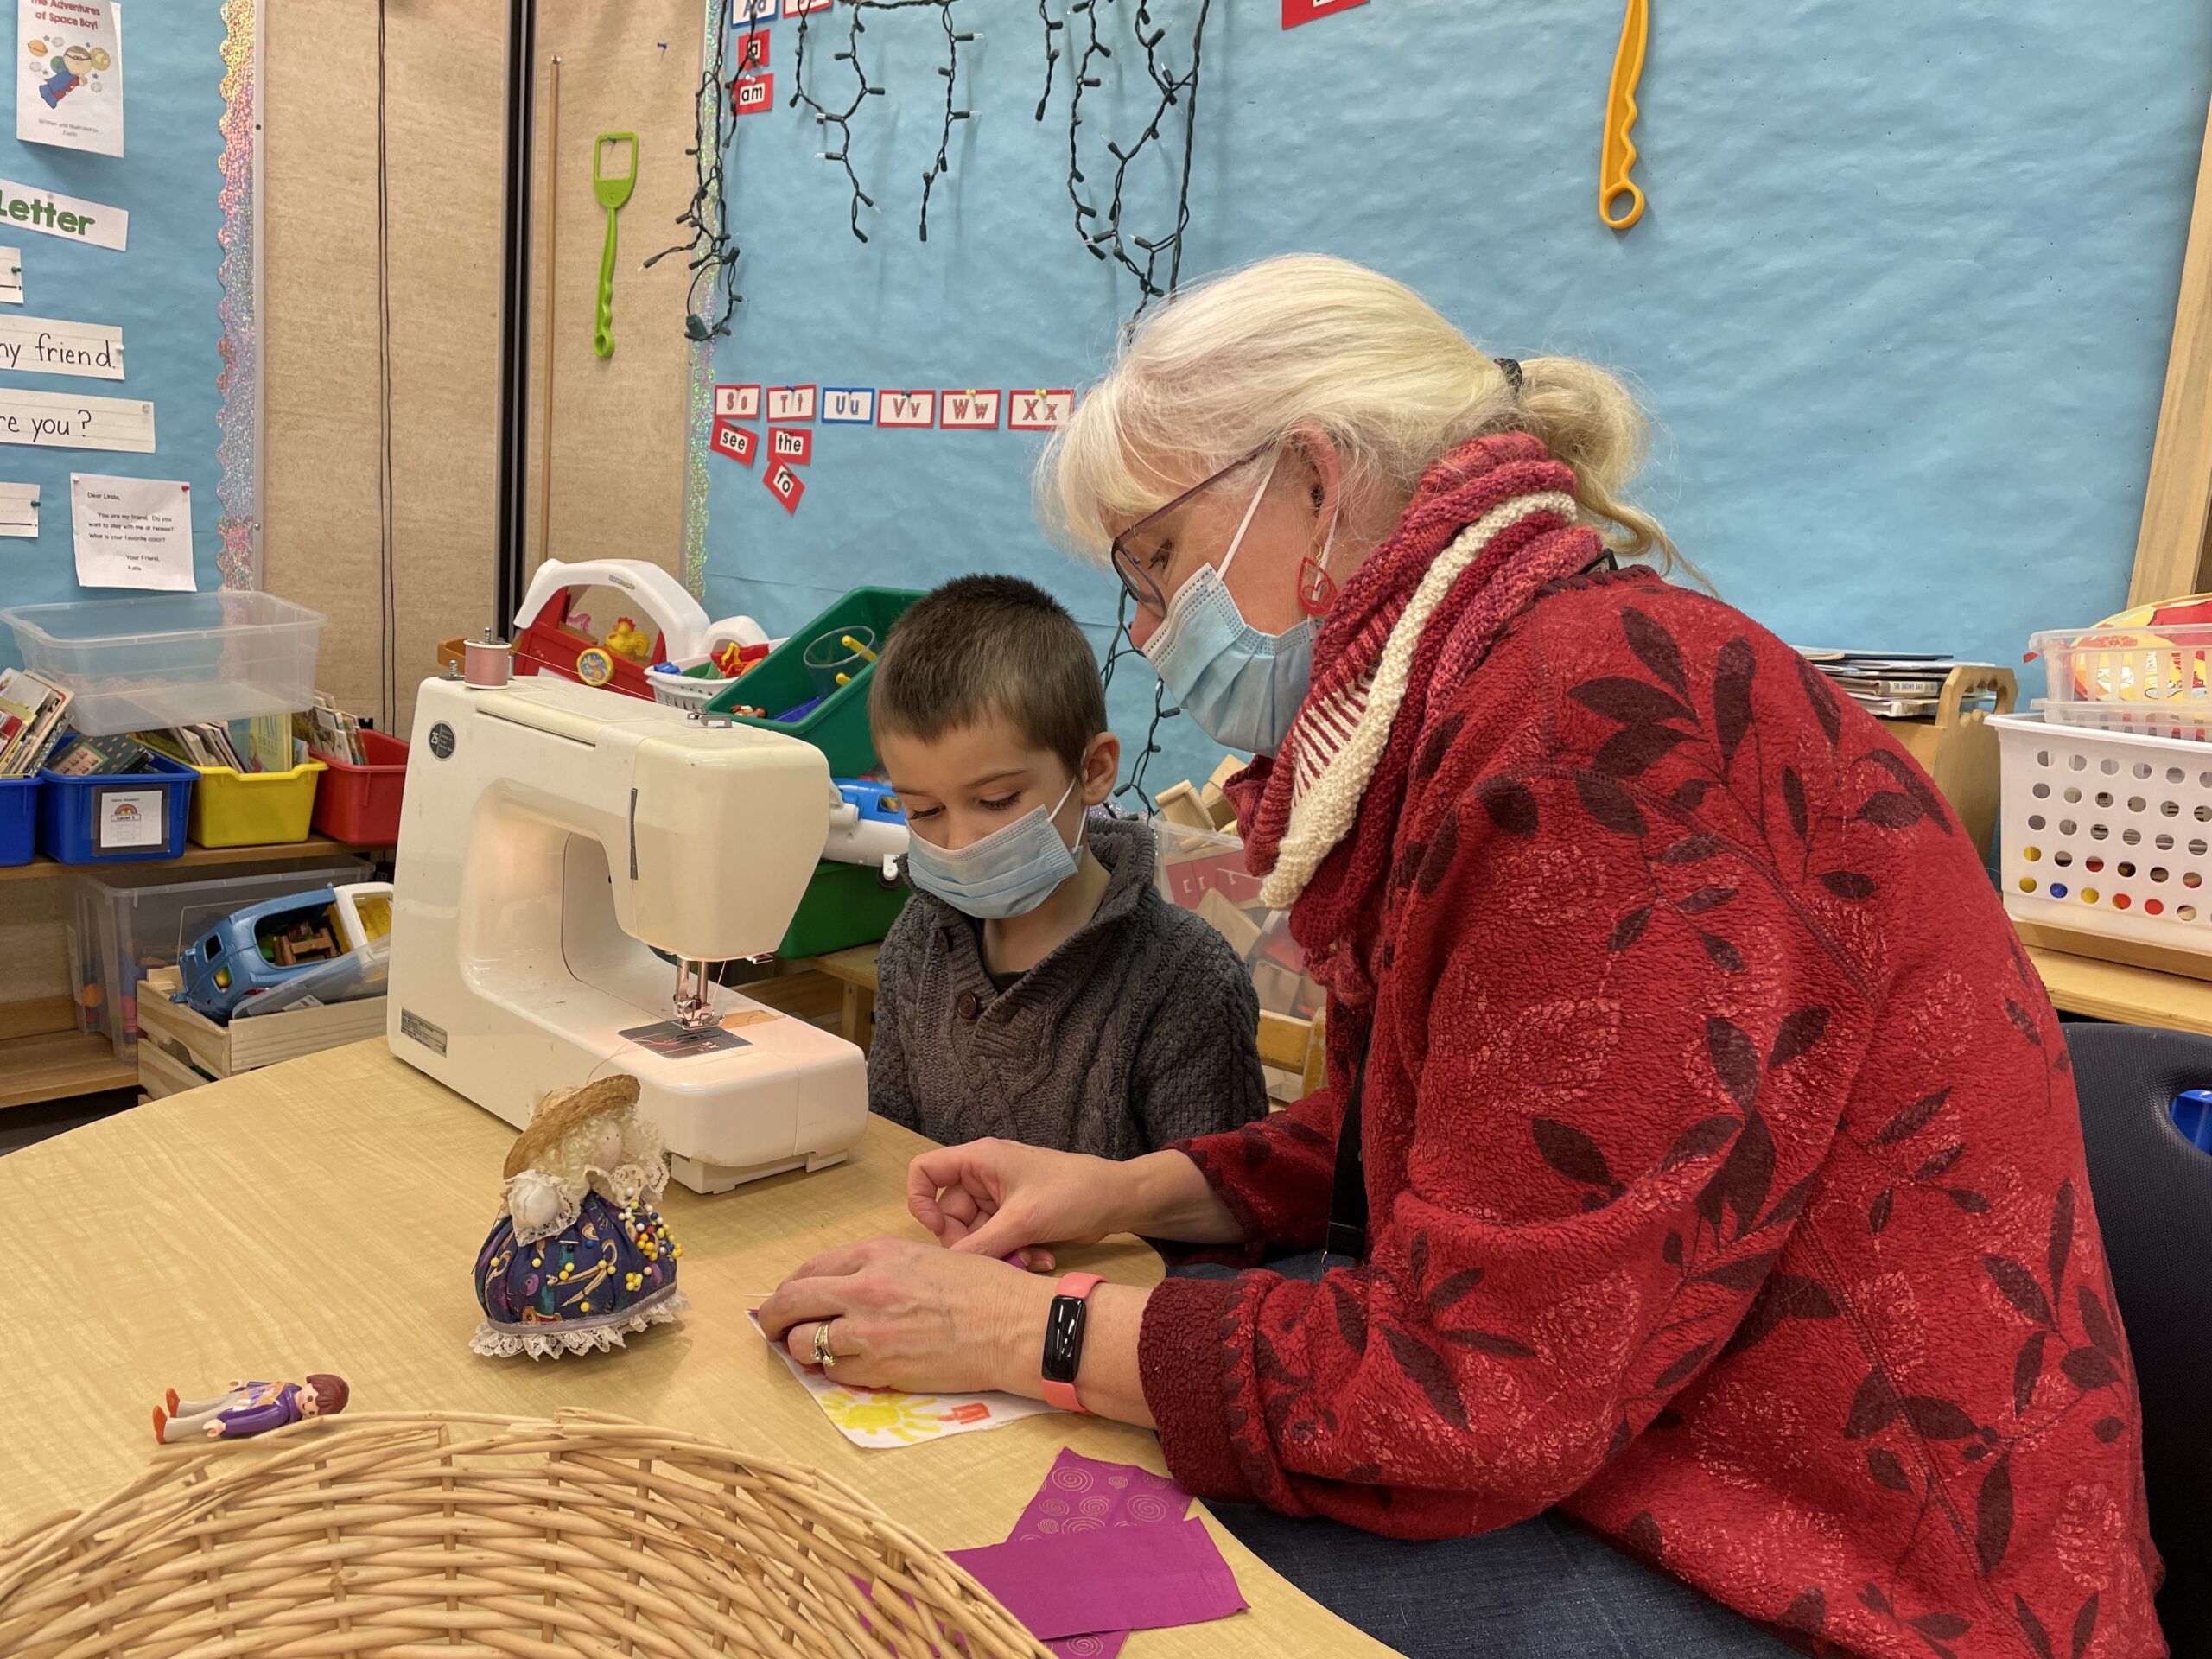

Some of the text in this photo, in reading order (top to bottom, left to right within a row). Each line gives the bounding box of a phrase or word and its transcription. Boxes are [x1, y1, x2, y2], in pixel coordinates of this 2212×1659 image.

[50, 0, 101, 16] Adventures
[35, 11, 99, 30] of Space Boy!
[741, 86, 763, 102] am
[0, 188, 96, 236] Letter
[35, 333, 116, 369] friend.
[721, 431, 746, 451] see
[778, 433, 802, 452] the
[776, 471, 791, 493] to
